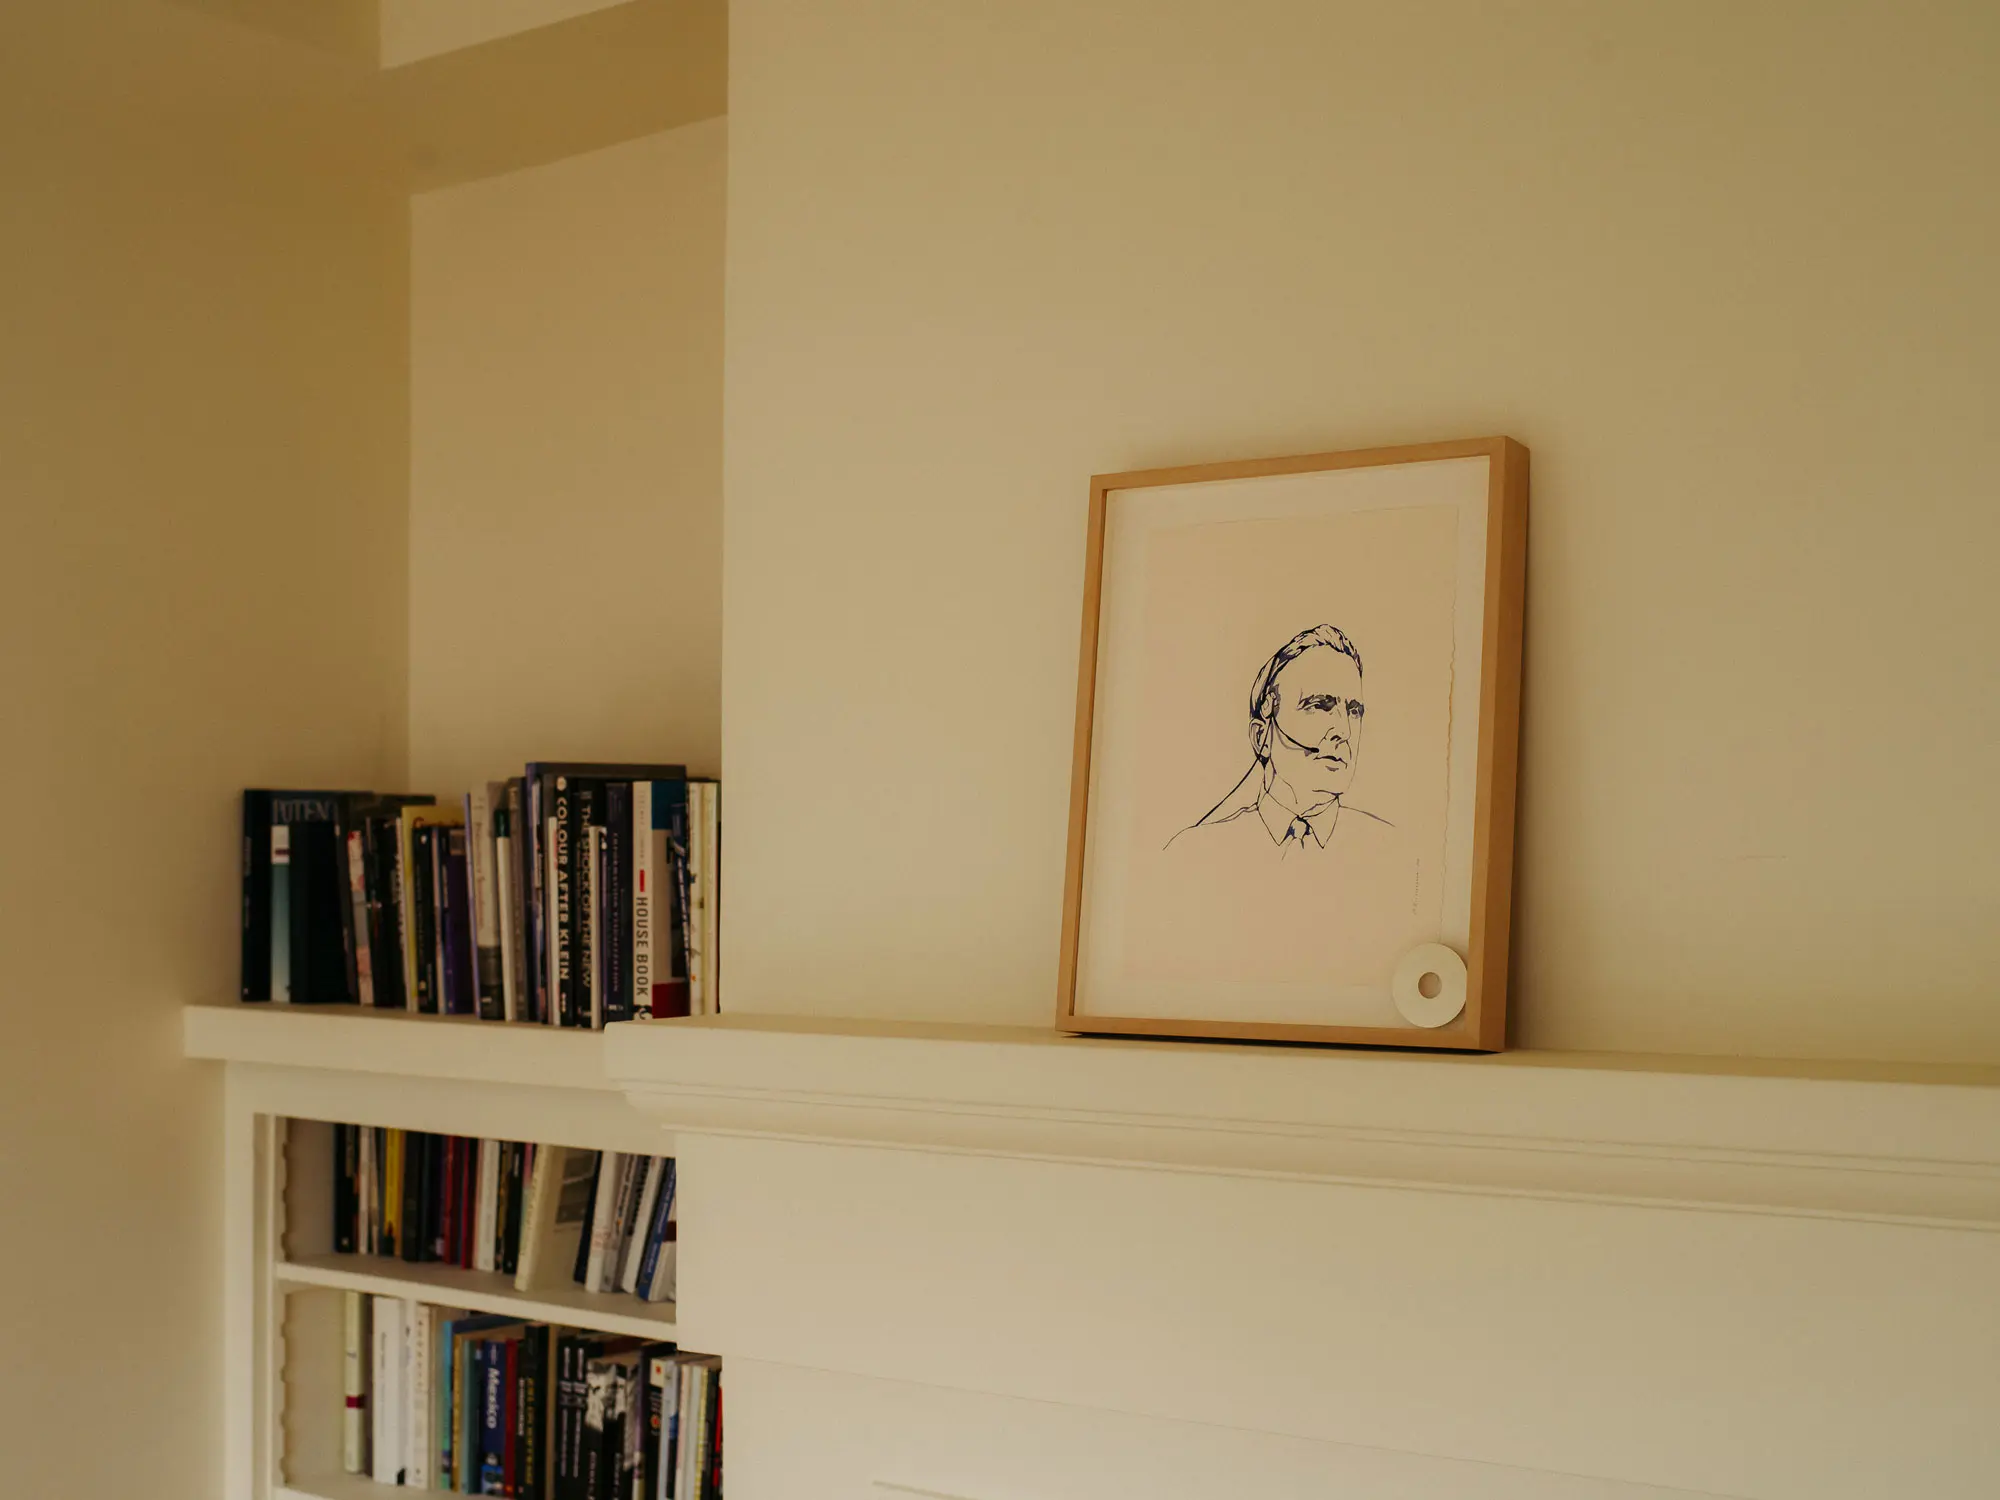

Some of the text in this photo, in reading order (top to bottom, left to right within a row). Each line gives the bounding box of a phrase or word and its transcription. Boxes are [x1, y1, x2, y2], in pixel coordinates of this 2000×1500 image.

[580, 805, 592, 835] THE
[557, 796, 570, 980] COLOUR AFTER KLEIN
[580, 840, 591, 890] SHOCK
[580, 949, 593, 988] NEW
[635, 896, 649, 997] HOUSE BOOK
[485, 1367, 502, 1430] Mexico
